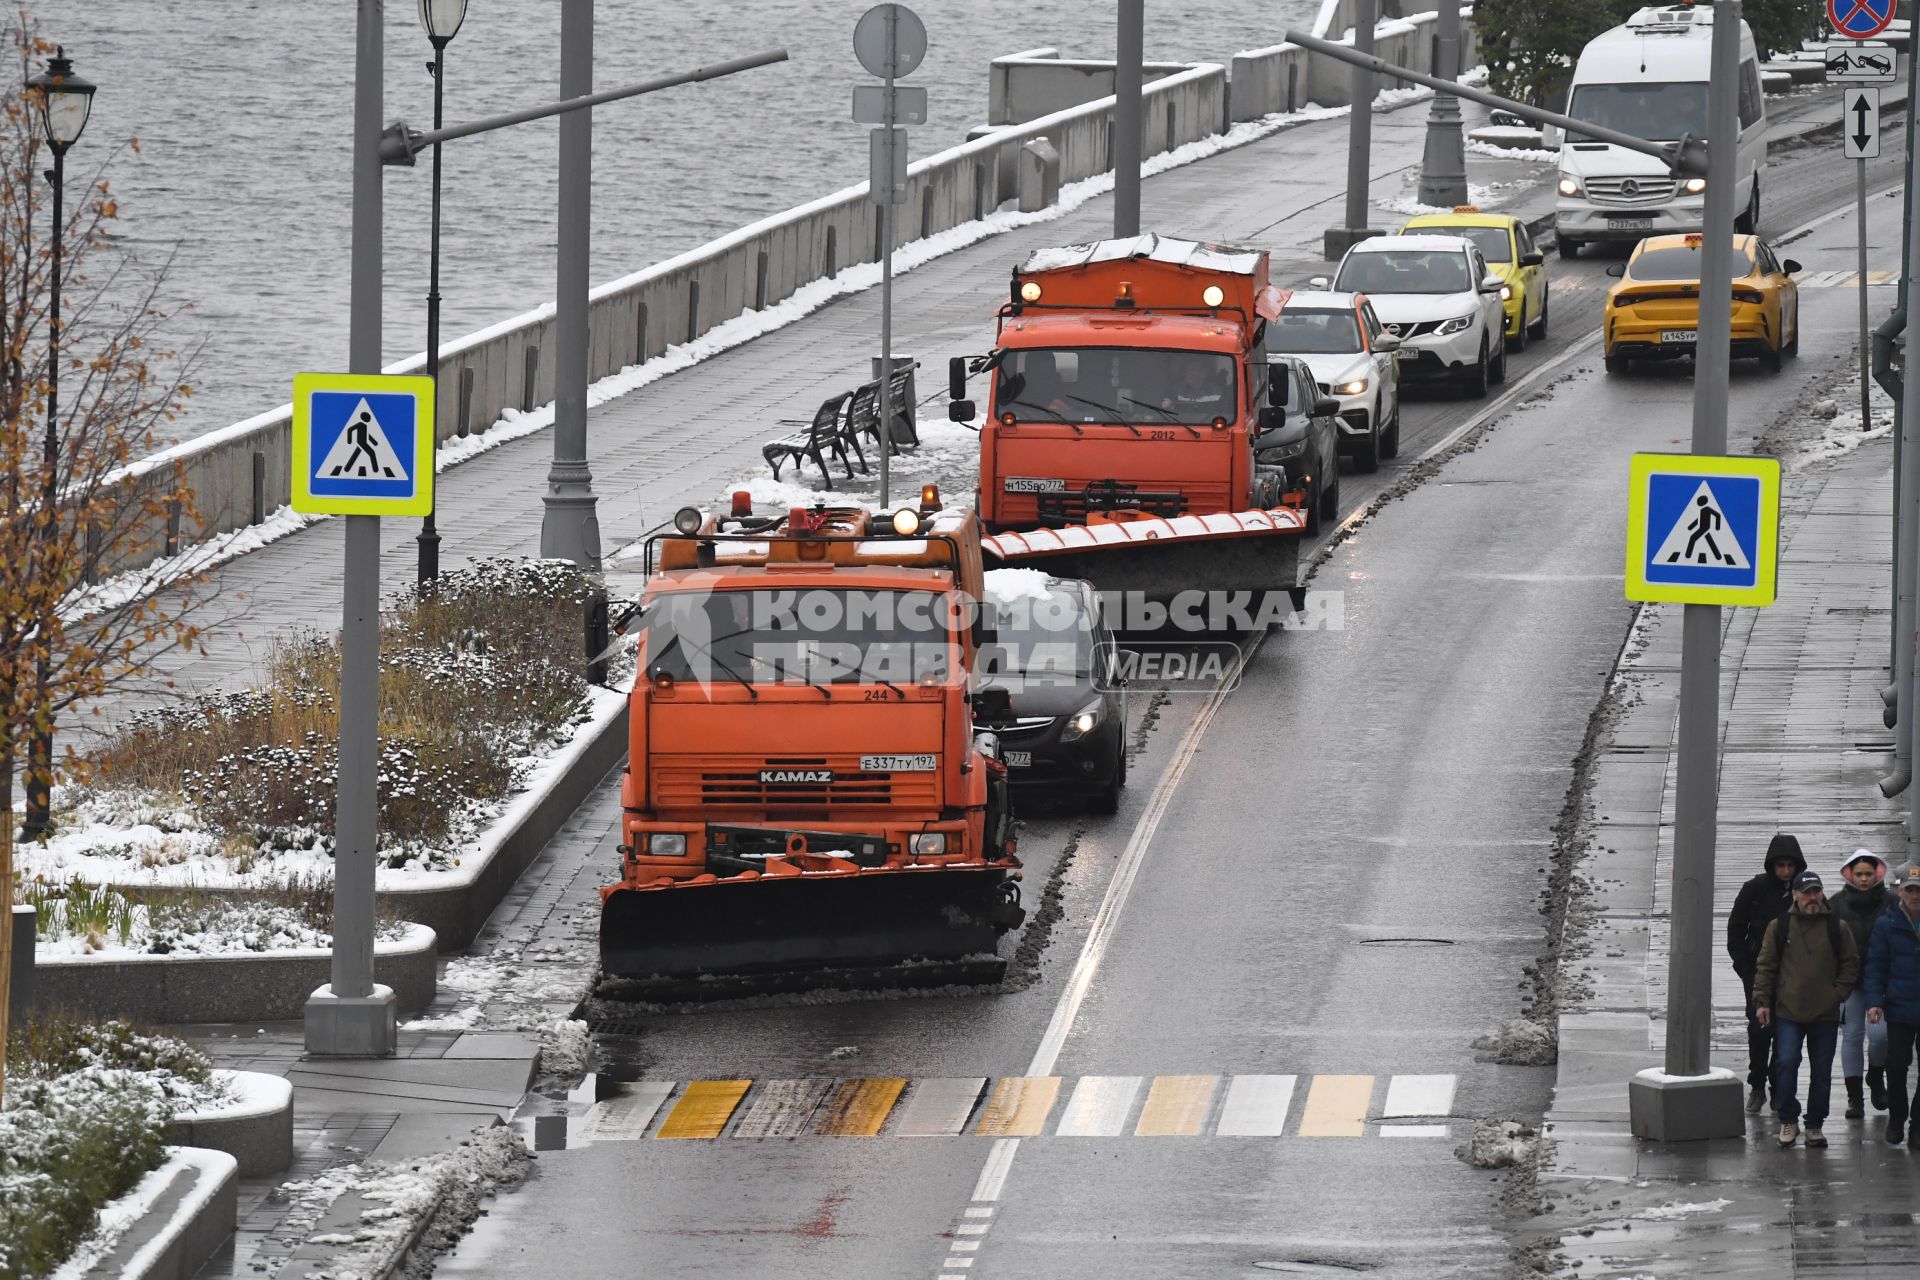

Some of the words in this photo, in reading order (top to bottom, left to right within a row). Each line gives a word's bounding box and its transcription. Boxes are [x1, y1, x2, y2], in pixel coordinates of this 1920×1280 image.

[1151, 431, 1175, 440] 2012
[864, 690, 888, 701] 244
[760, 771, 831, 782] KAMAZ
